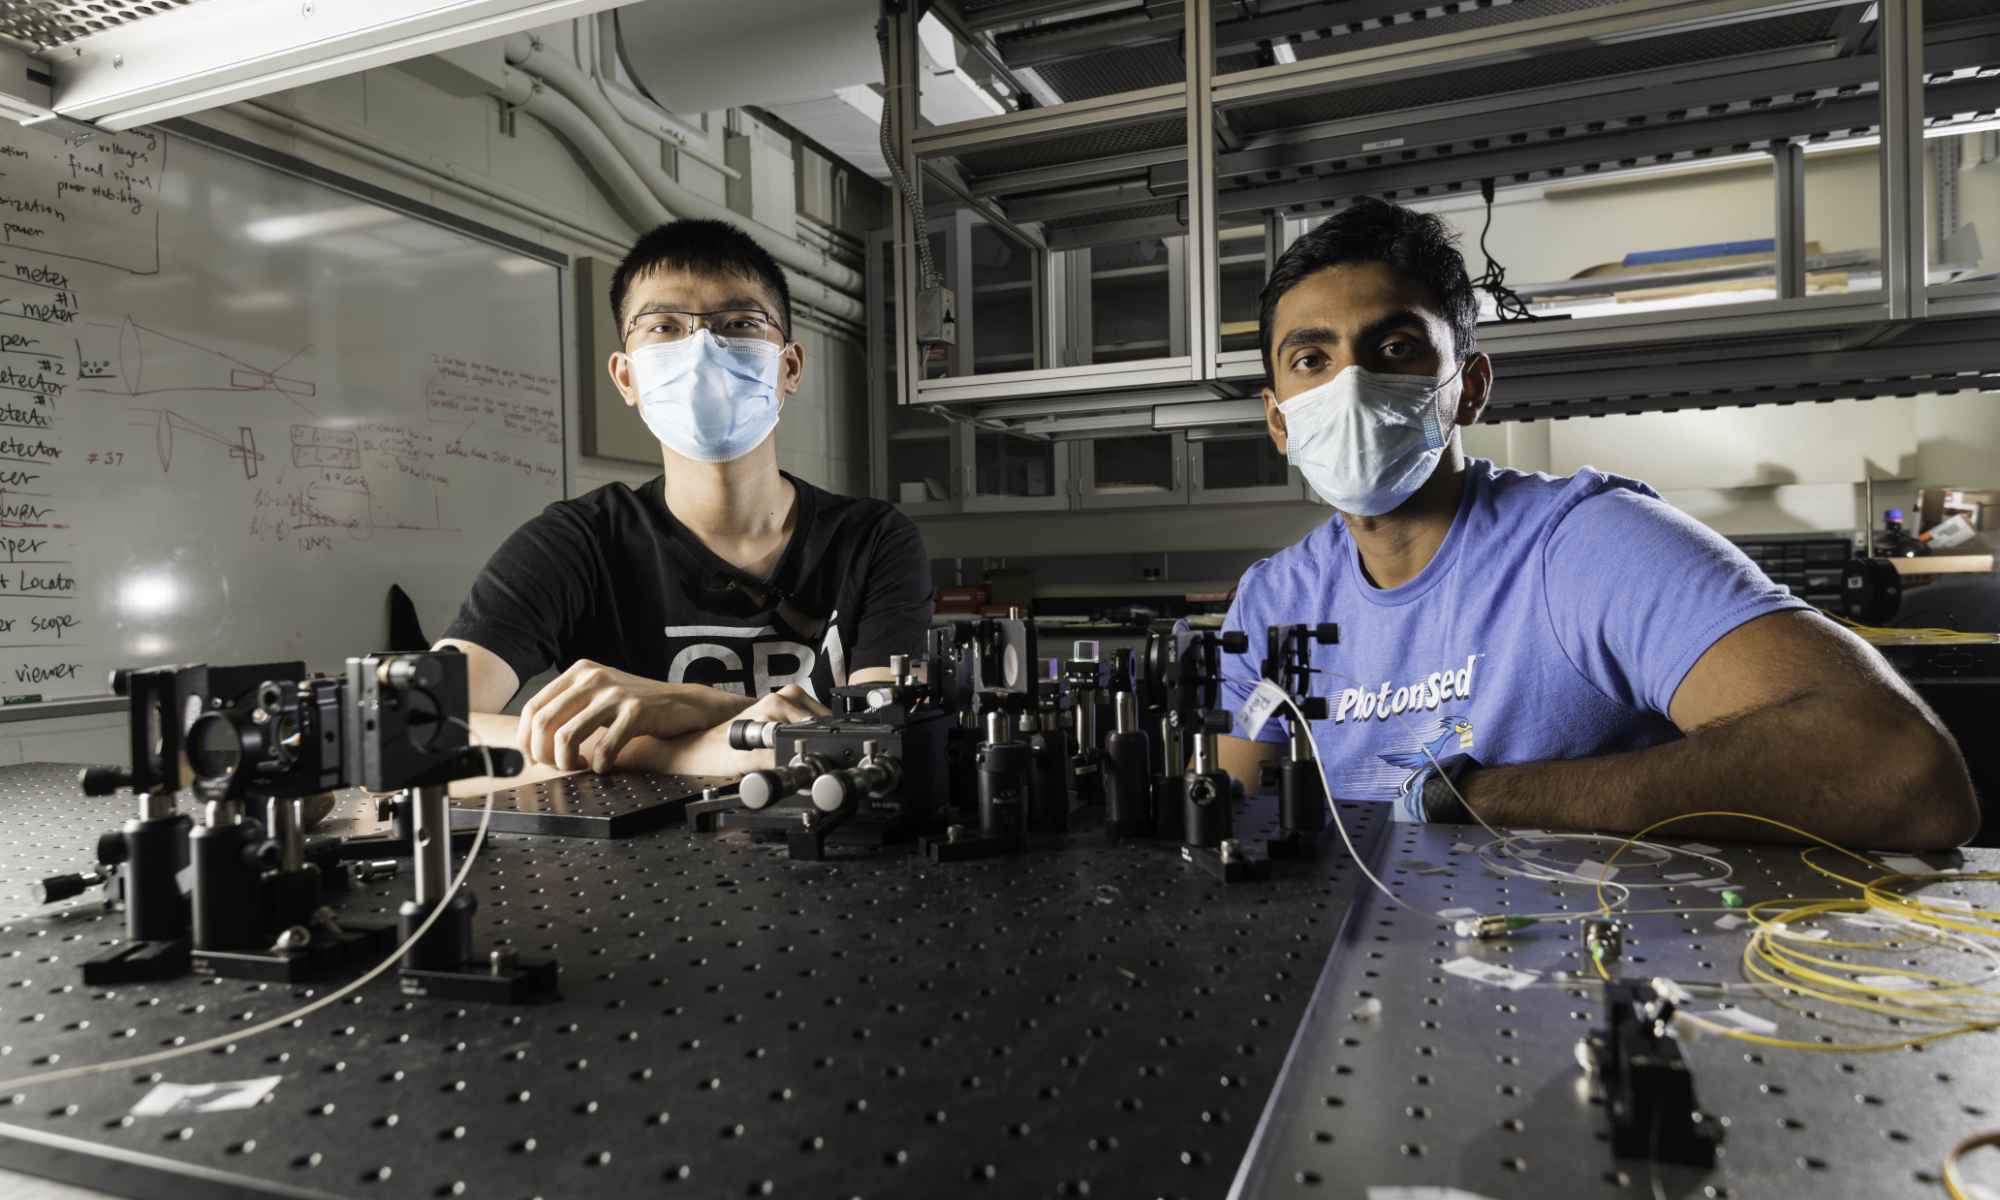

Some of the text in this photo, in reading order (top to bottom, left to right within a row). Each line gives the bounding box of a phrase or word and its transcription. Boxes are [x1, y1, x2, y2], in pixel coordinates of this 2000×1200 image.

[15, 264, 69, 289] meter
[22, 301, 79, 323] meter
[31, 613, 80, 639] scope
[15, 663, 83, 684] viewer
